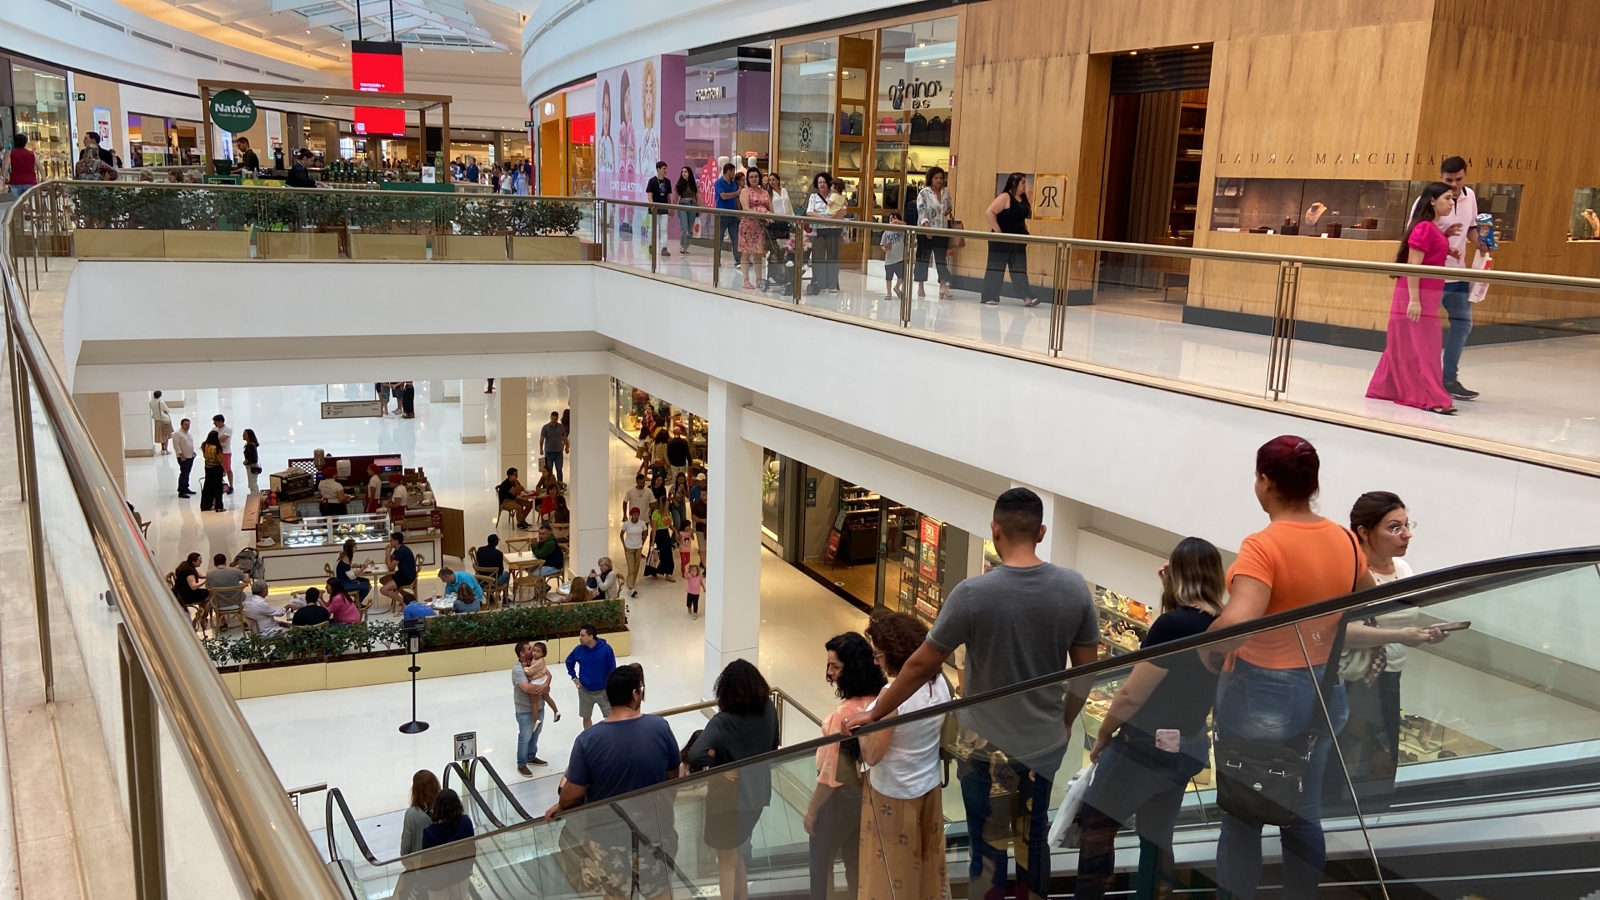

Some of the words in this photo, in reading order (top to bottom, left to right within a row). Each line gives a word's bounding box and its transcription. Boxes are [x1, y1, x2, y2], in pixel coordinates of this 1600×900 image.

[214, 102, 252, 114] Native
[674, 110, 736, 129] croc
[1315, 153, 1410, 165] MARCHI
[1485, 157, 1540, 171] MARCHI
